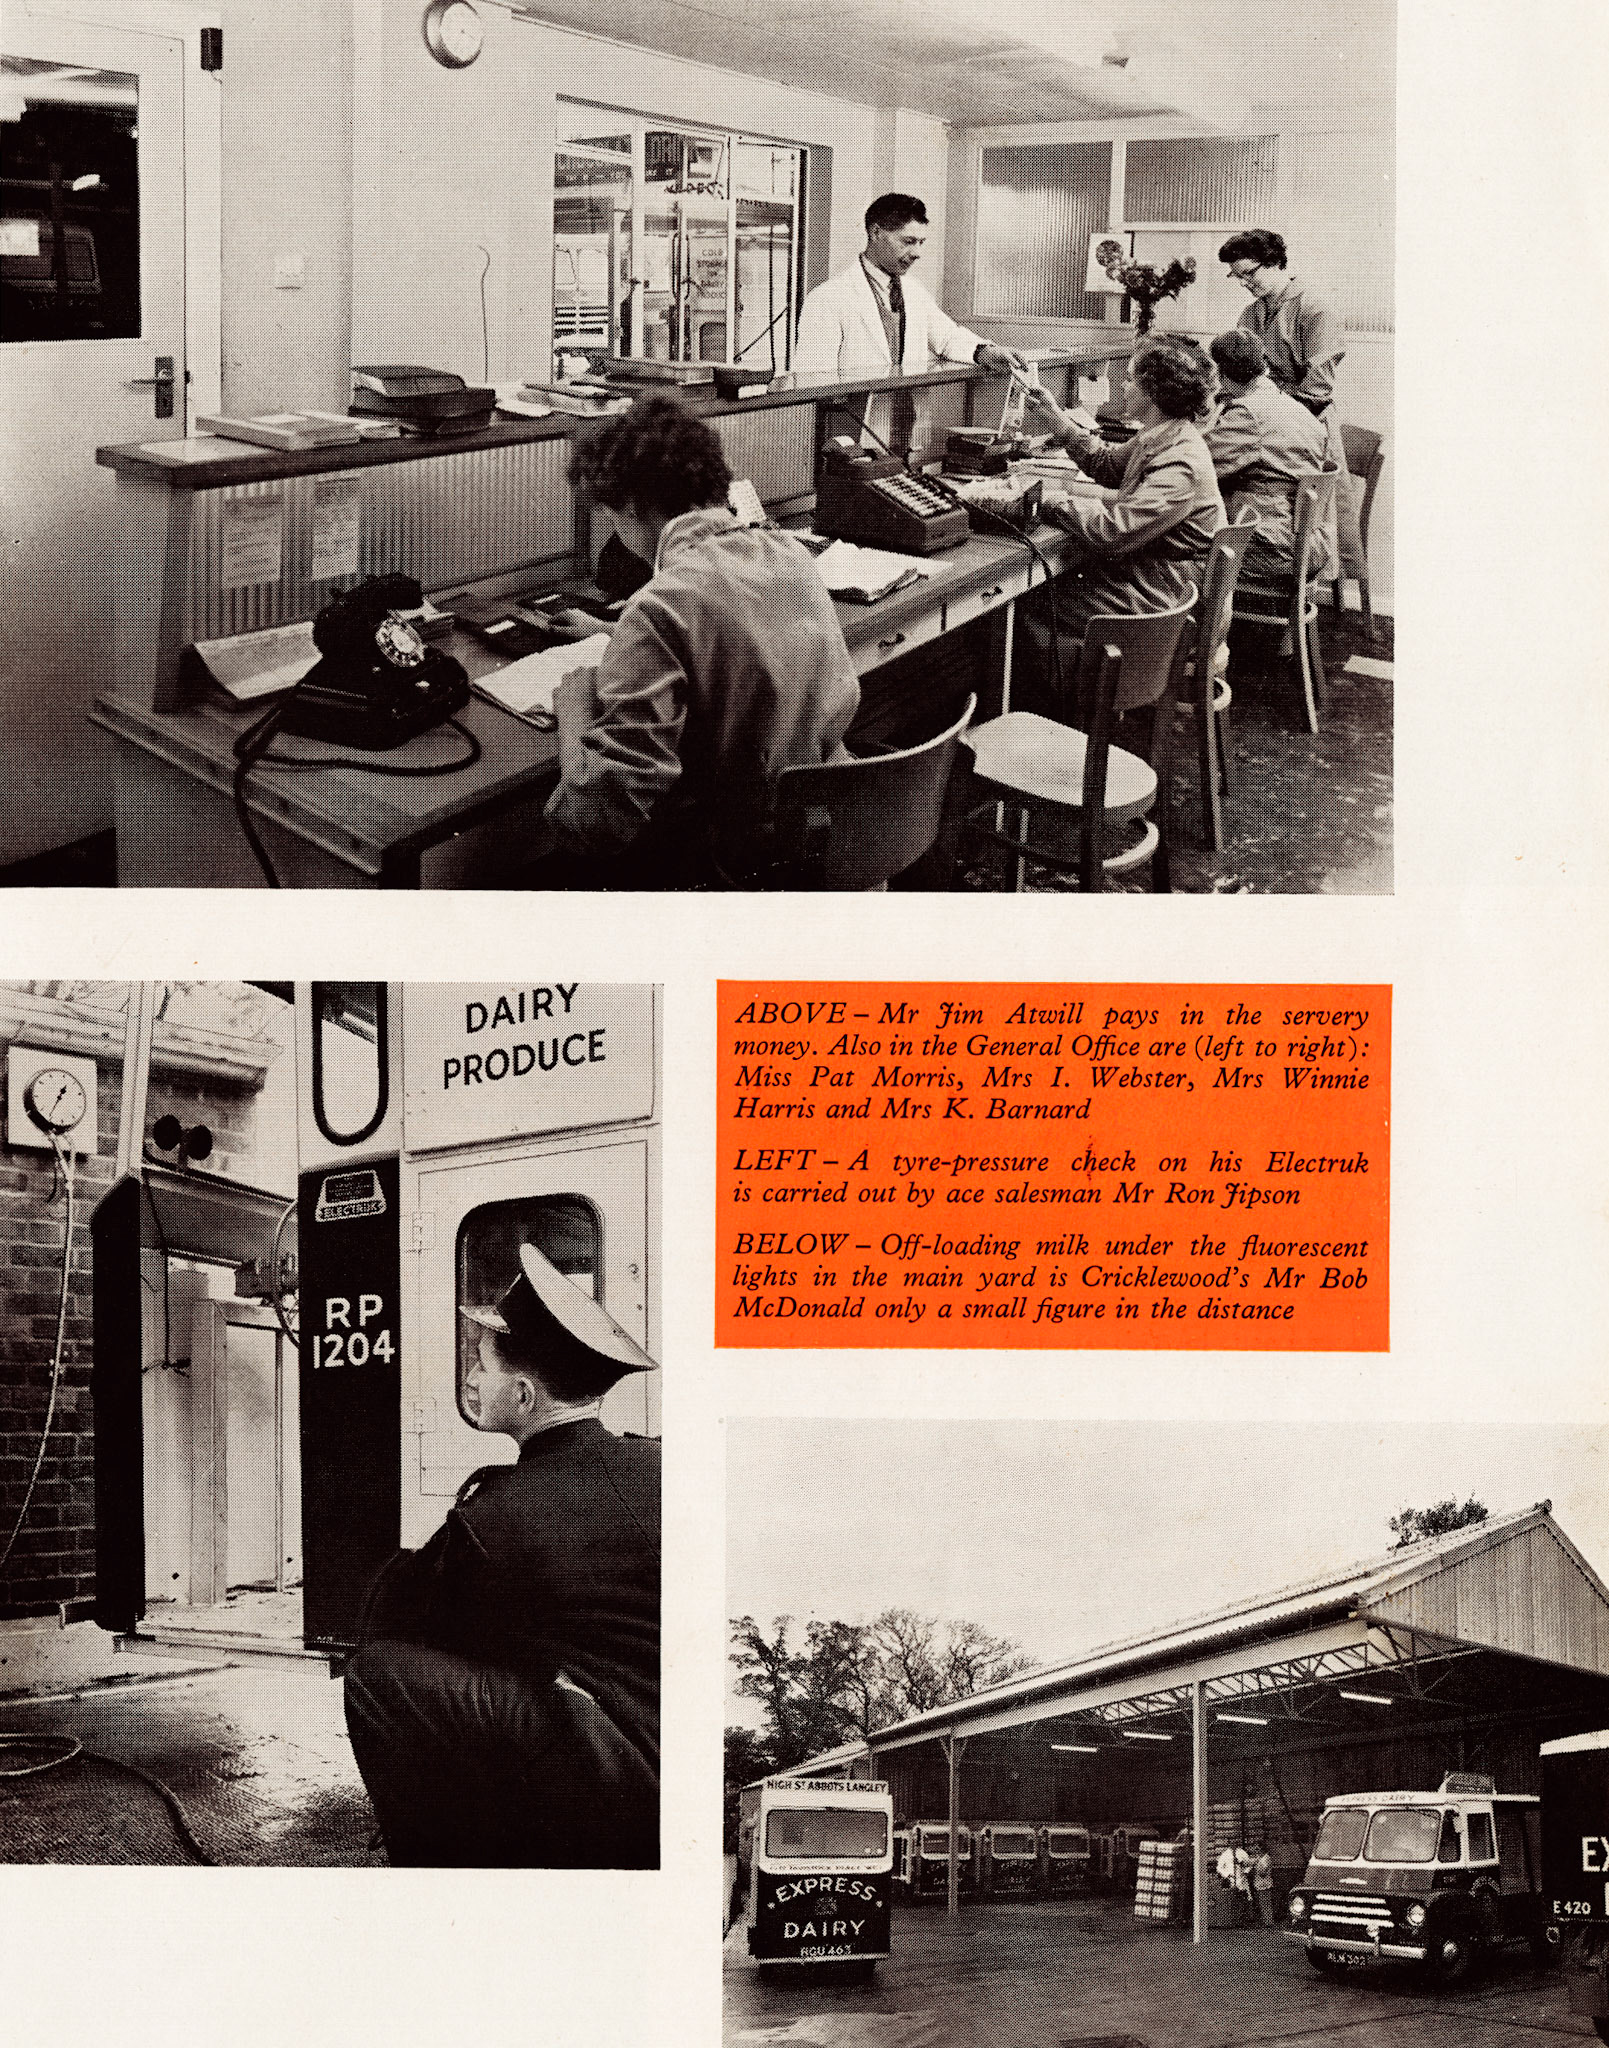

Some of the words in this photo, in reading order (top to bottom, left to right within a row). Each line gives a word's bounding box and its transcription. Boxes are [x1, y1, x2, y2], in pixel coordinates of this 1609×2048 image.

[466, 983, 580, 1034] DAIRY
[734, 1002, 847, 1024] ABOVE
[877, 1002, 919, 1024] Mr
[935, 1002, 983, 1029] Jim
[1004, 1002, 1084, 1025] Atwill
[1103, 1007, 1159, 1030] pays
[1180, 1002, 1204, 1025] in
[1226, 1003, 1262, 1025] the
[1282, 1010, 1369, 1031] servery
[444, 1028, 606, 1090] PRODUCE
[734, 1040, 817, 1061] money.
[827, 1033, 881, 1056] Also
[889, 1034, 913, 1056] in
[922, 1034, 958, 1056] the
[966, 1034, 1063, 1056] General
[1071, 1034, 1140, 1061] Office
[1148, 1041, 1186, 1057] are
[1195, 1035, 1245, 1062] (left
[1255, 1040, 1277, 1057] to
[1287, 1035, 1369, 1062] right):
[735, 1065, 792, 1087] Miss
[809, 1065, 855, 1087] Pat
[871, 1065, 964, 1091] Morris,
[981, 1066, 1033, 1088] Mrs
[1051, 1066, 1070, 1088] I.
[1091, 1066, 1194, 1092] Webster,
[1212, 1067, 1264, 1088] Mrs
[1283, 1067, 1369, 1089] Winnie
[733, 1096, 816, 1119] Harris
[826, 1097, 872, 1119] and
[881, 1097, 932, 1119] Mrs
[943, 1097, 974, 1119] K.
[985, 1098, 1092, 1120] Barnard
[733, 1149, 817, 1171] LEFT
[847, 1149, 868, 1171] A
[893, 1154, 1049, 1177] tyre-pressure
[1071, 1149, 1136, 1172] check
[1158, 1157, 1187, 1172] on
[1209, 1150, 1243, 1172] his
[1265, 1151, 1369, 1174] Electruk
[733, 1180, 752, 1202] is
[762, 1180, 849, 1203] carried
[858, 1186, 897, 1203] out
[907, 1181, 935, 1208] by
[946, 1188, 985, 1203] ace
[994, 1181, 1102, 1204] salesman
[1112, 1182, 1155, 1203] Mr
[1165, 1182, 1215, 1204] Ron
[1220, 1182, 1300, 1209] Jipson
[733, 1233, 850, 1255] BELOW
[881, 1233, 1021, 1260] Off-loading
[1036, 1233, 1089, 1256] milk
[1106, 1233, 1174, 1256] under
[1190, 1234, 1226, 1256] the
[1237, 1234, 1369, 1261] fluorescent
[732, 1264, 798, 1291] lights
[813, 1264, 837, 1287] in
[852, 1265, 888, 1287] the
[903, 1272, 963, 1287] main
[975, 1265, 1037, 1292] yard
[1049, 1265, 1068, 1287] is
[1082, 1265, 1250, 1288] Cricklewood's
[1263, 1267, 1306, 1288] Mr
[1319, 1267, 1368, 1289] Bob
[733, 1296, 865, 1318] McDonald
[875, 1296, 926, 1323] only
[937, 1304, 952, 1318] a
[962, 1296, 1027, 1318] small
[1032, 1296, 1106, 1324] figure
[1116, 1296, 1139, 1319] in
[1151, 1297, 1187, 1319] the
[1197, 1297, 1295, 1320] distance
[313, 1330, 396, 1370] 1204
[807, 1781, 845, 1792] ABBOTS
[846, 1782, 888, 1793] LANGLEY
[775, 1876, 878, 1903] EXPRESS
[1563, 1900, 1592, 1915] 420
[784, 1919, 866, 1939] DAIRY
